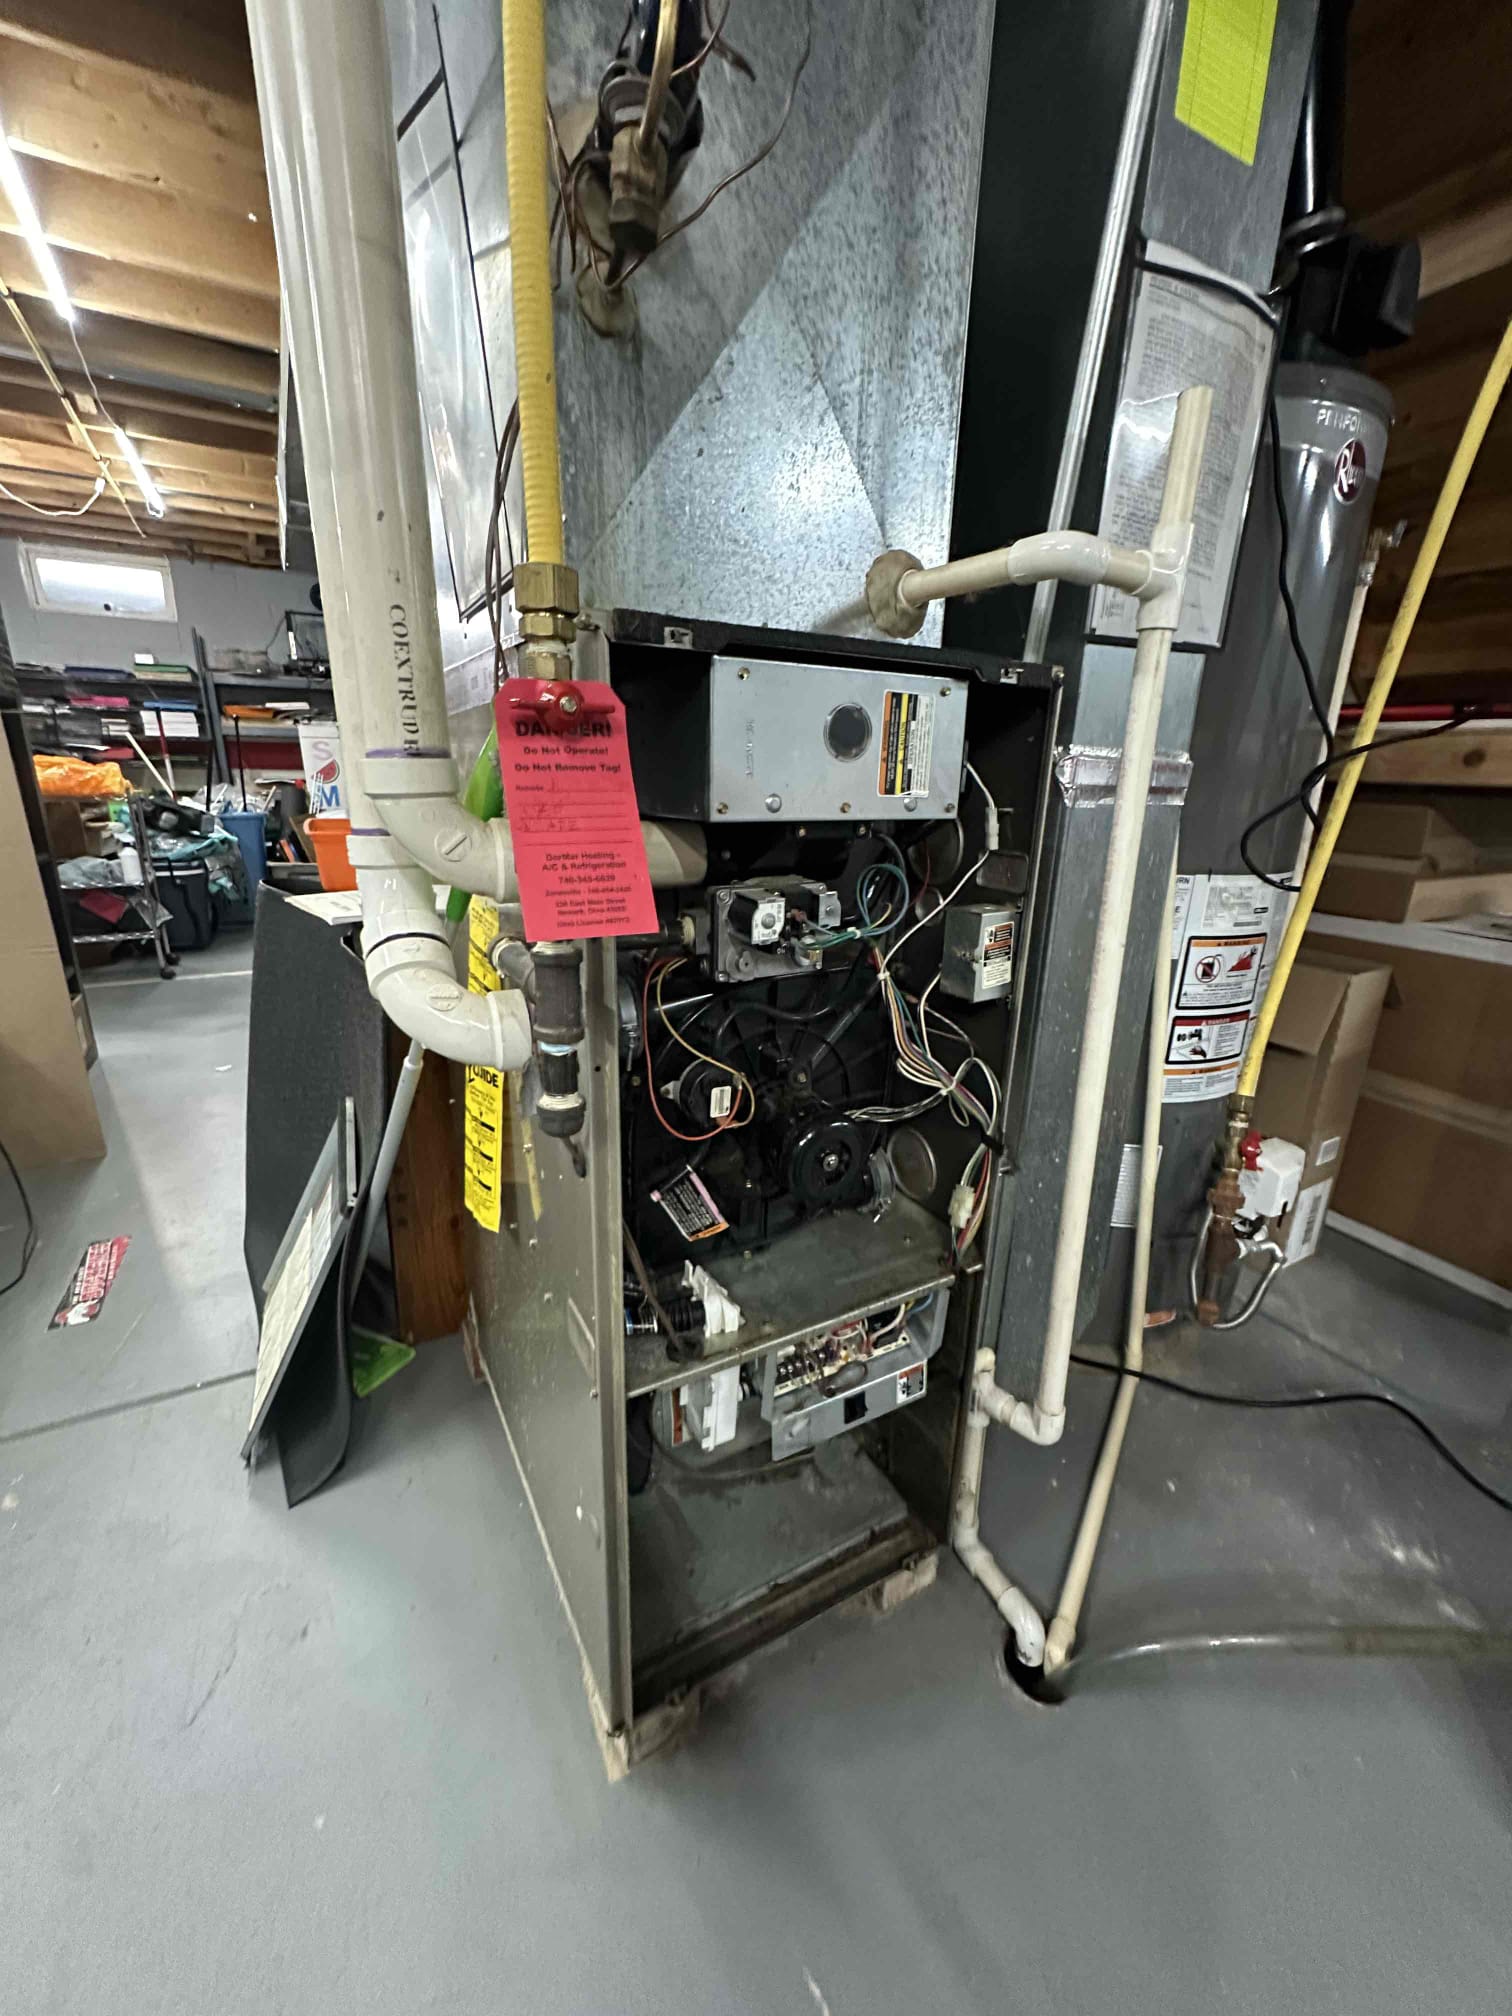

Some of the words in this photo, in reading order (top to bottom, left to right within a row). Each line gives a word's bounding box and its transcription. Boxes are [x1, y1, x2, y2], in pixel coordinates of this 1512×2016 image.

[523, 746, 538, 754] Do
[541, 746, 560, 755] Not
[563, 745, 609, 755] Operate!
[515, 763, 529, 772] Do
[533, 763, 551, 772] Not
[555, 763, 596, 772] Remove
[581, 851, 615, 861] Heating
[571, 862, 627, 871] Refrigeration
